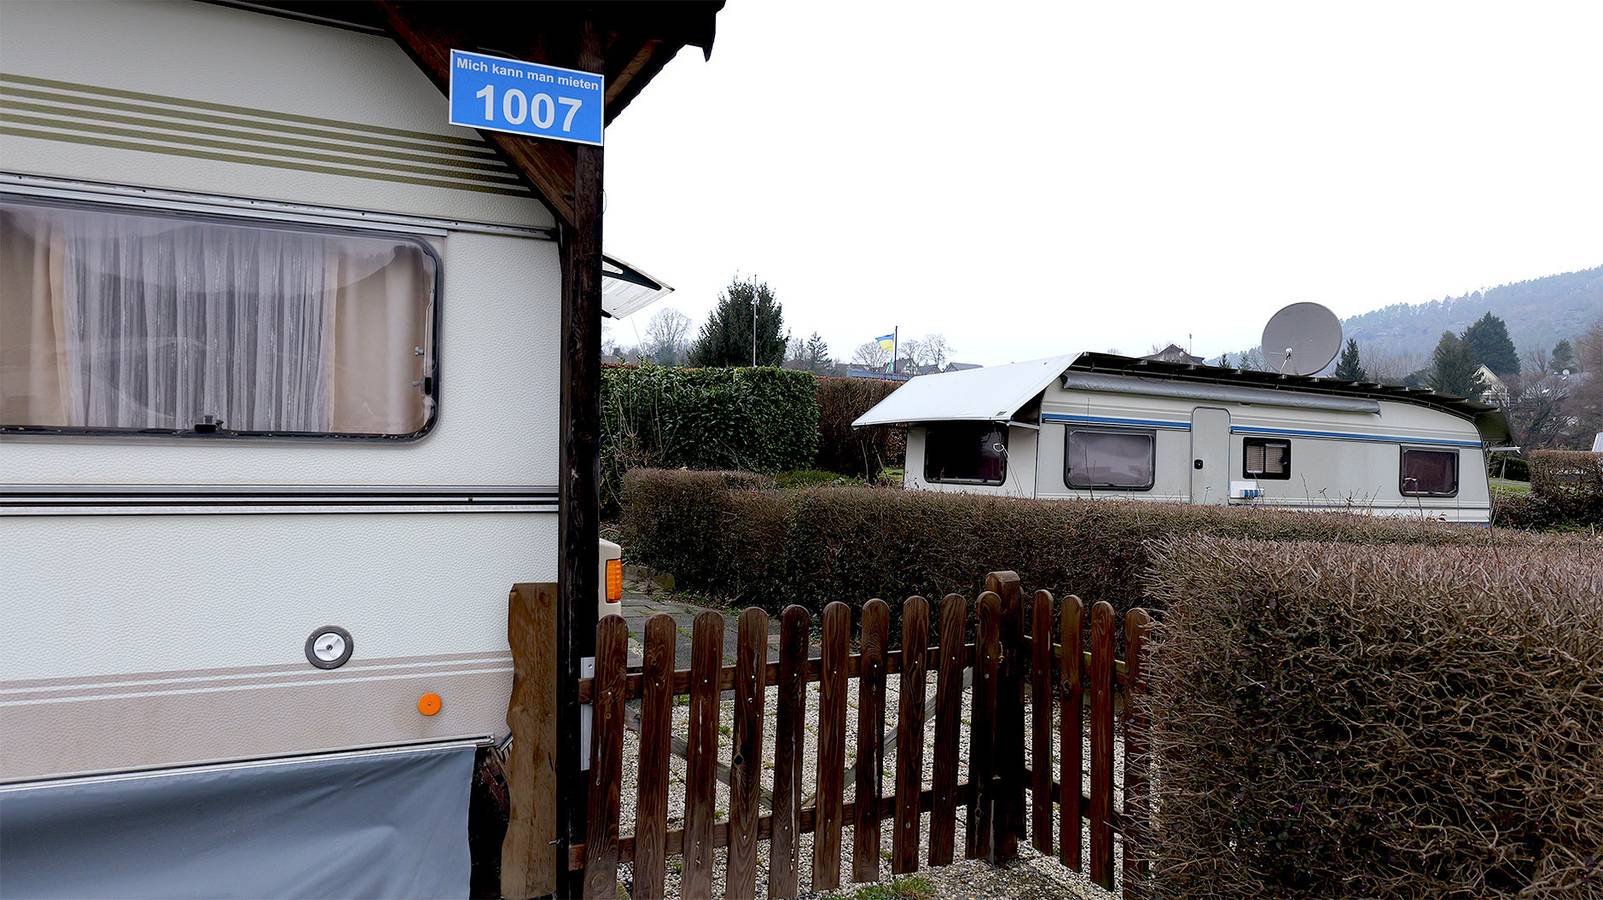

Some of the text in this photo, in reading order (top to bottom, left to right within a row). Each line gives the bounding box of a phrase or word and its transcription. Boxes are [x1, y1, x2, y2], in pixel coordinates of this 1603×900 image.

[457, 57, 599, 91] Mich kann man mieten
[476, 84, 583, 132] 1007
